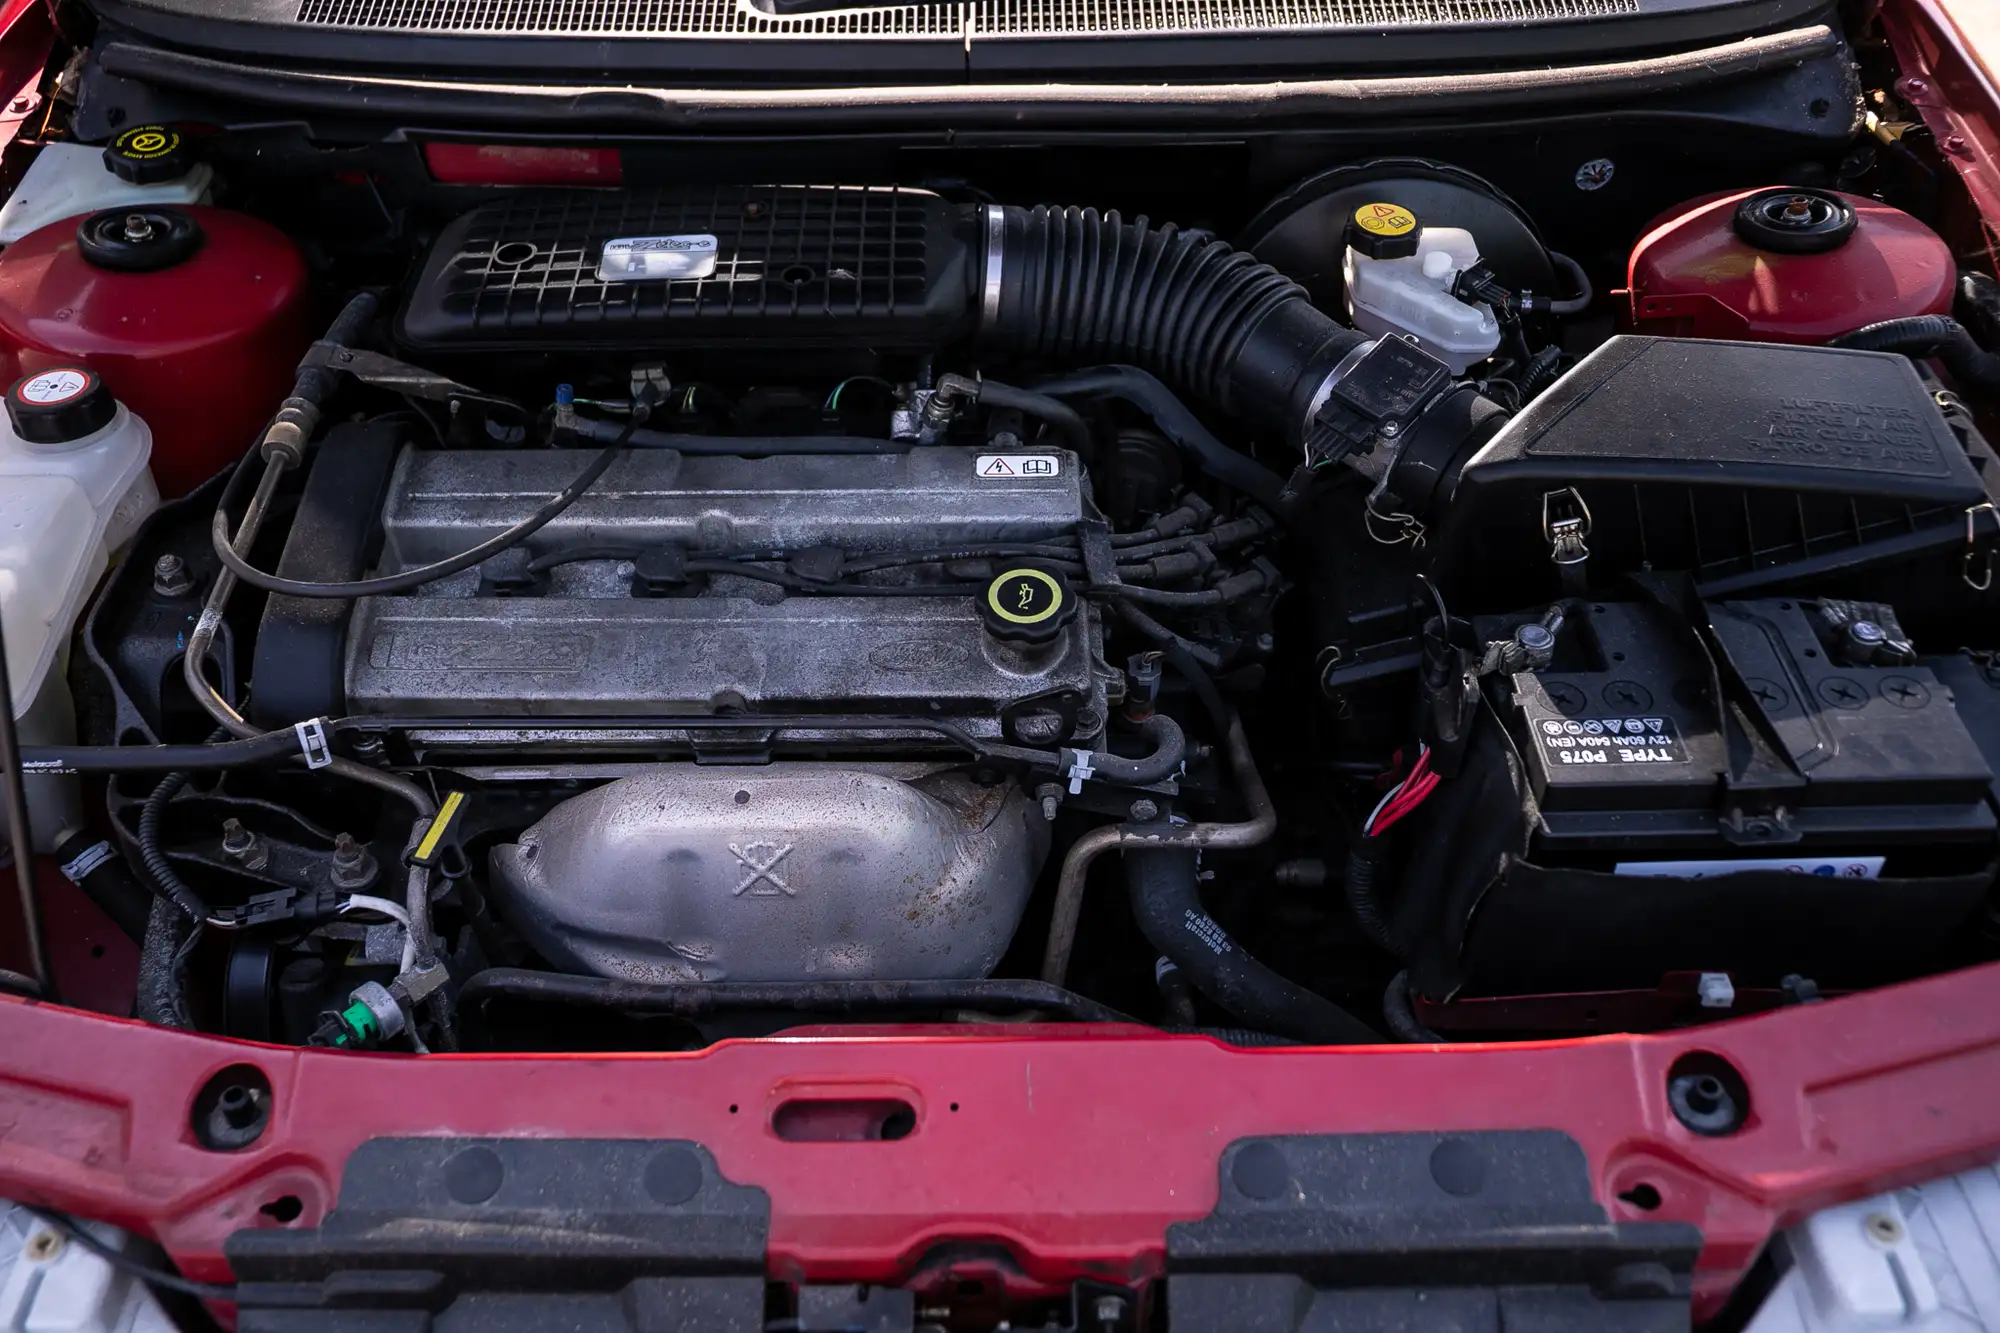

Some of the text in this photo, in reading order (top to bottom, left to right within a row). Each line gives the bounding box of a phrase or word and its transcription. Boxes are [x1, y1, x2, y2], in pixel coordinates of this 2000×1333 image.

[1779, 397, 1916, 420] LUFTFILTER
[1817, 428, 1928, 449] CLEANER
[1546, 736, 1576, 747] (EN)
[1612, 735, 1646, 746] 60Ah
[1648, 735, 1673, 745] 12V
[1560, 748, 1673, 763] TYPE P075
[1185, 920, 1223, 955] Motorcraft
